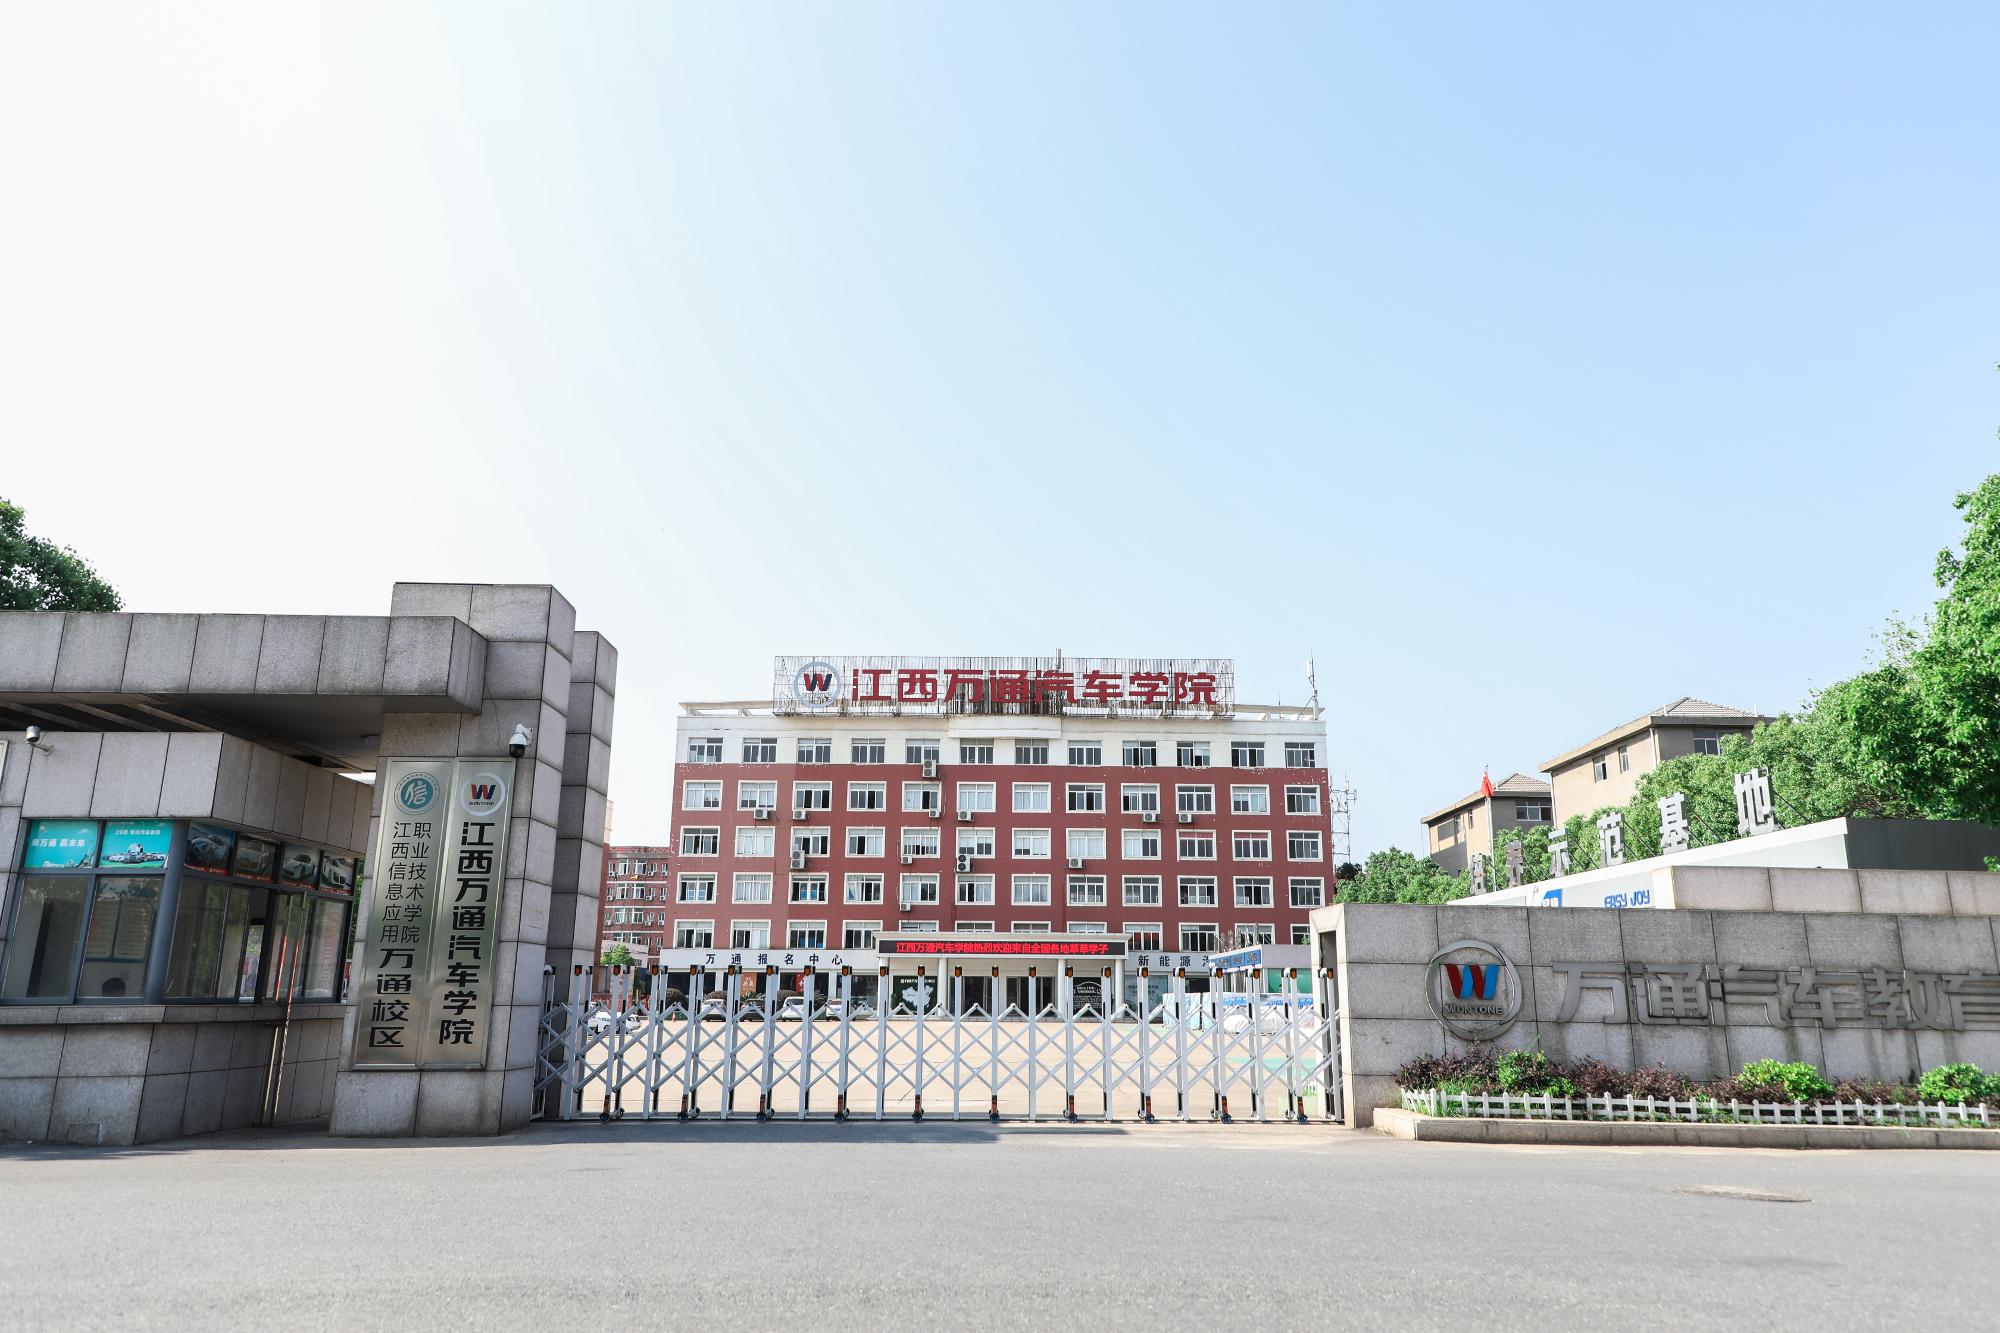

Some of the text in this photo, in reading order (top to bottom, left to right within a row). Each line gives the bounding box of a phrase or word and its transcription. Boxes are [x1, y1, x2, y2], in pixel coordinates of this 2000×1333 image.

[852, 669, 1217, 706] 江西万通汽车学院
[1470, 767, 1777, 897] 培养示范基地
[1604, 889, 1650, 909] EASY JOY
[438, 821, 496, 1046] 江西万通汽车学院
[705, 953, 843, 966] 万通报名中心
[369, 948, 416, 1048] 万通校区
[1445, 1003, 1504, 1015] WONTONE
[1551, 961, 2000, 1032] 万通汽车教育
